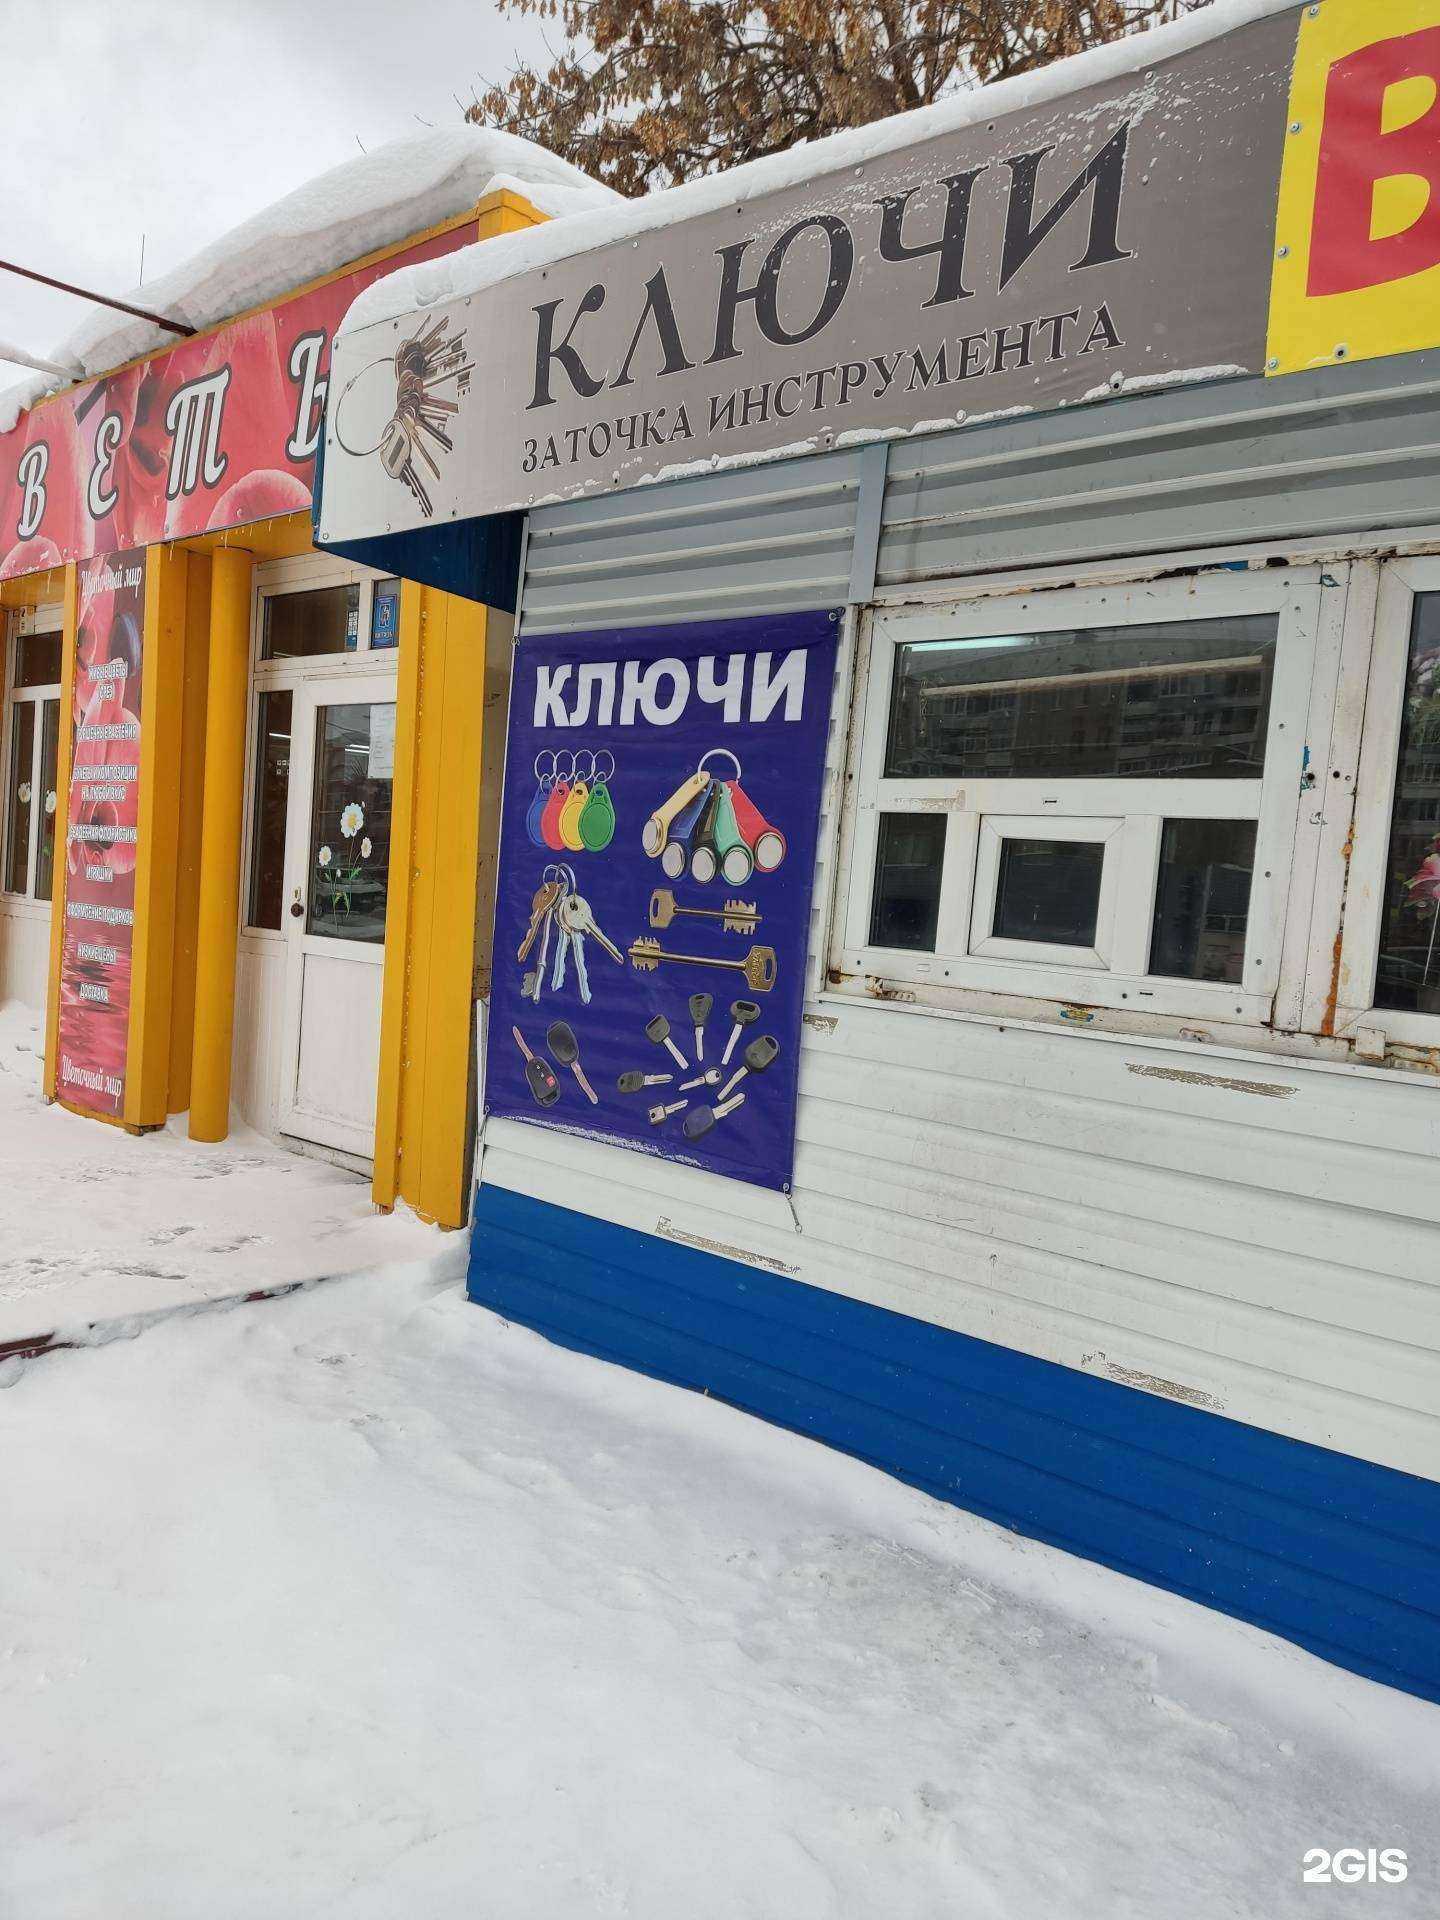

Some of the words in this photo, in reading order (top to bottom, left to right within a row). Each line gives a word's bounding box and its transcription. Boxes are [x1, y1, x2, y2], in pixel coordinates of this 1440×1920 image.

[525, 120, 1134, 411] КЛЮЧИ
[521, 402, 695, 474] ЗАТОЧКА
[707, 301, 1127, 431] ИНСТРУМЕНТА
[533, 648, 809, 728] КЛЮЧИ
[104, 1074, 122, 1108] мир
